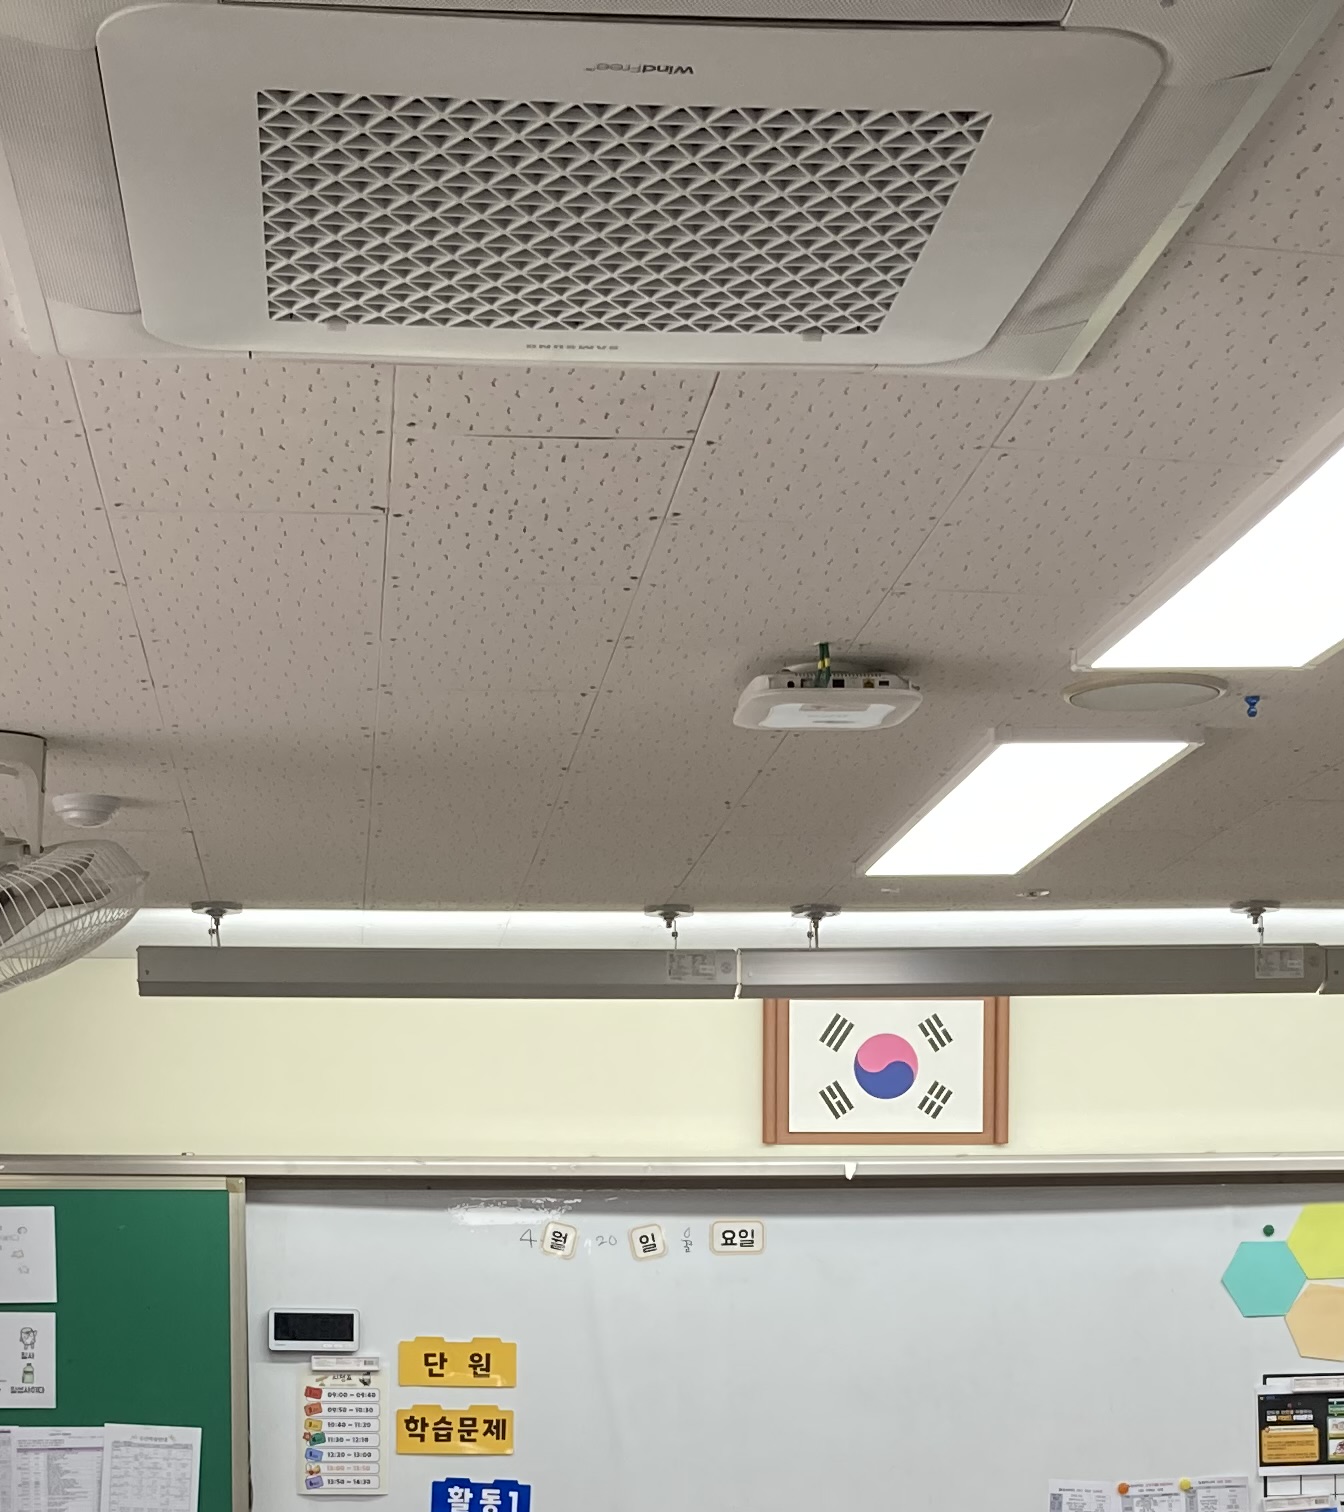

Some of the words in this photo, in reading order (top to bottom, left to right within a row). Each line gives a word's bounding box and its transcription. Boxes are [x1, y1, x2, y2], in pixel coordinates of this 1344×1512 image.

[520, 1228, 537, 1248] 4
[550, 1230, 568, 1250] 월
[596, 1235, 617, 1246] 20
[639, 1233, 657, 1253] 일
[721, 1229, 754, 1248] 요일
[404, 1415, 506, 1443] 학습문제
